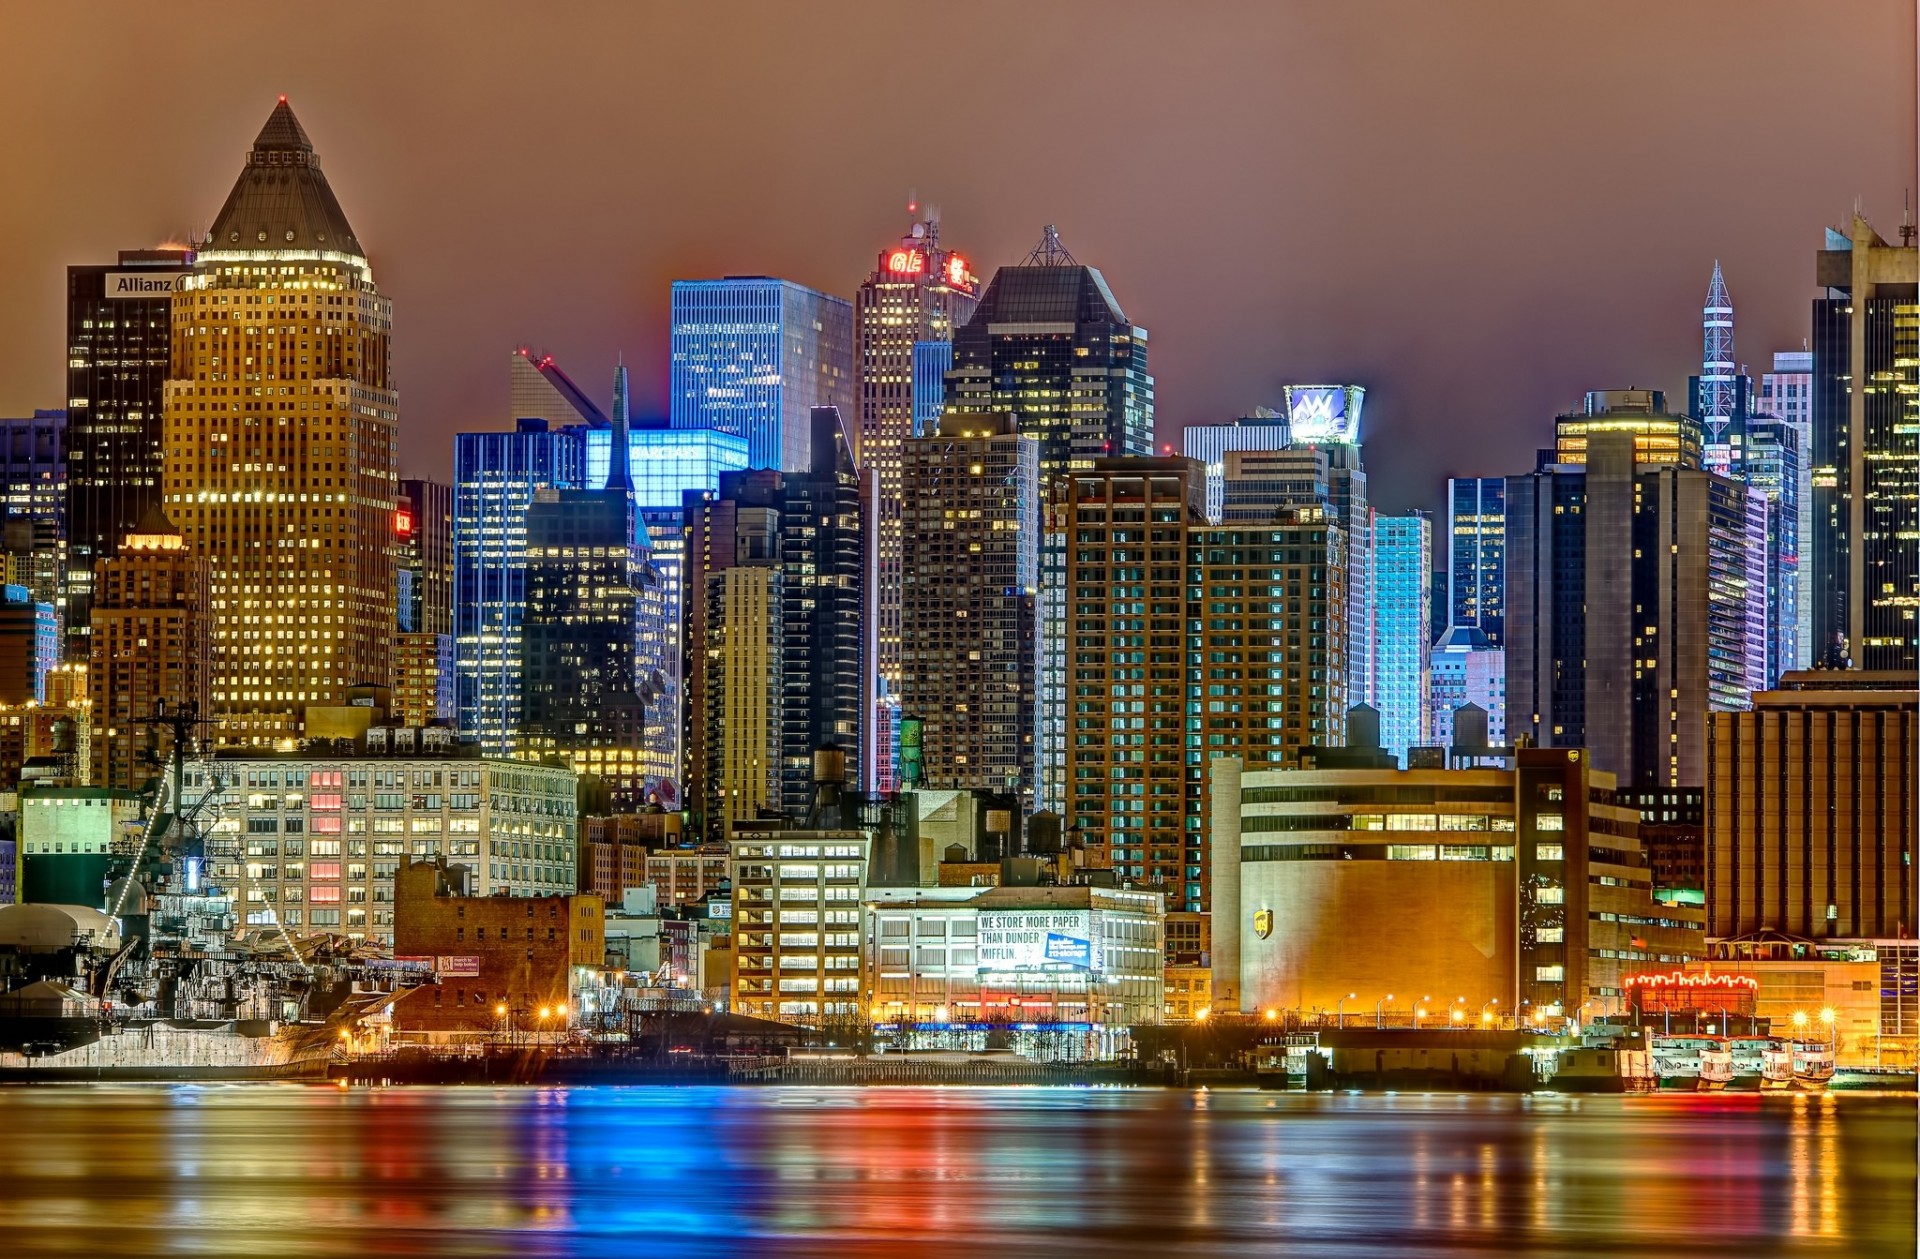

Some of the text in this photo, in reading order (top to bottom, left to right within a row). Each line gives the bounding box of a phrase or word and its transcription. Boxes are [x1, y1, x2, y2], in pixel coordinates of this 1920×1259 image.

[889, 252, 922, 272] GE
[117, 278, 171, 291] Allianz
[981, 916, 1080, 928] WE STORE MORE PAPER
[981, 932, 1003, 944] THAN
[1006, 932, 1039, 944] DUNDER
[981, 948, 1017, 960] MIFFLIN.
